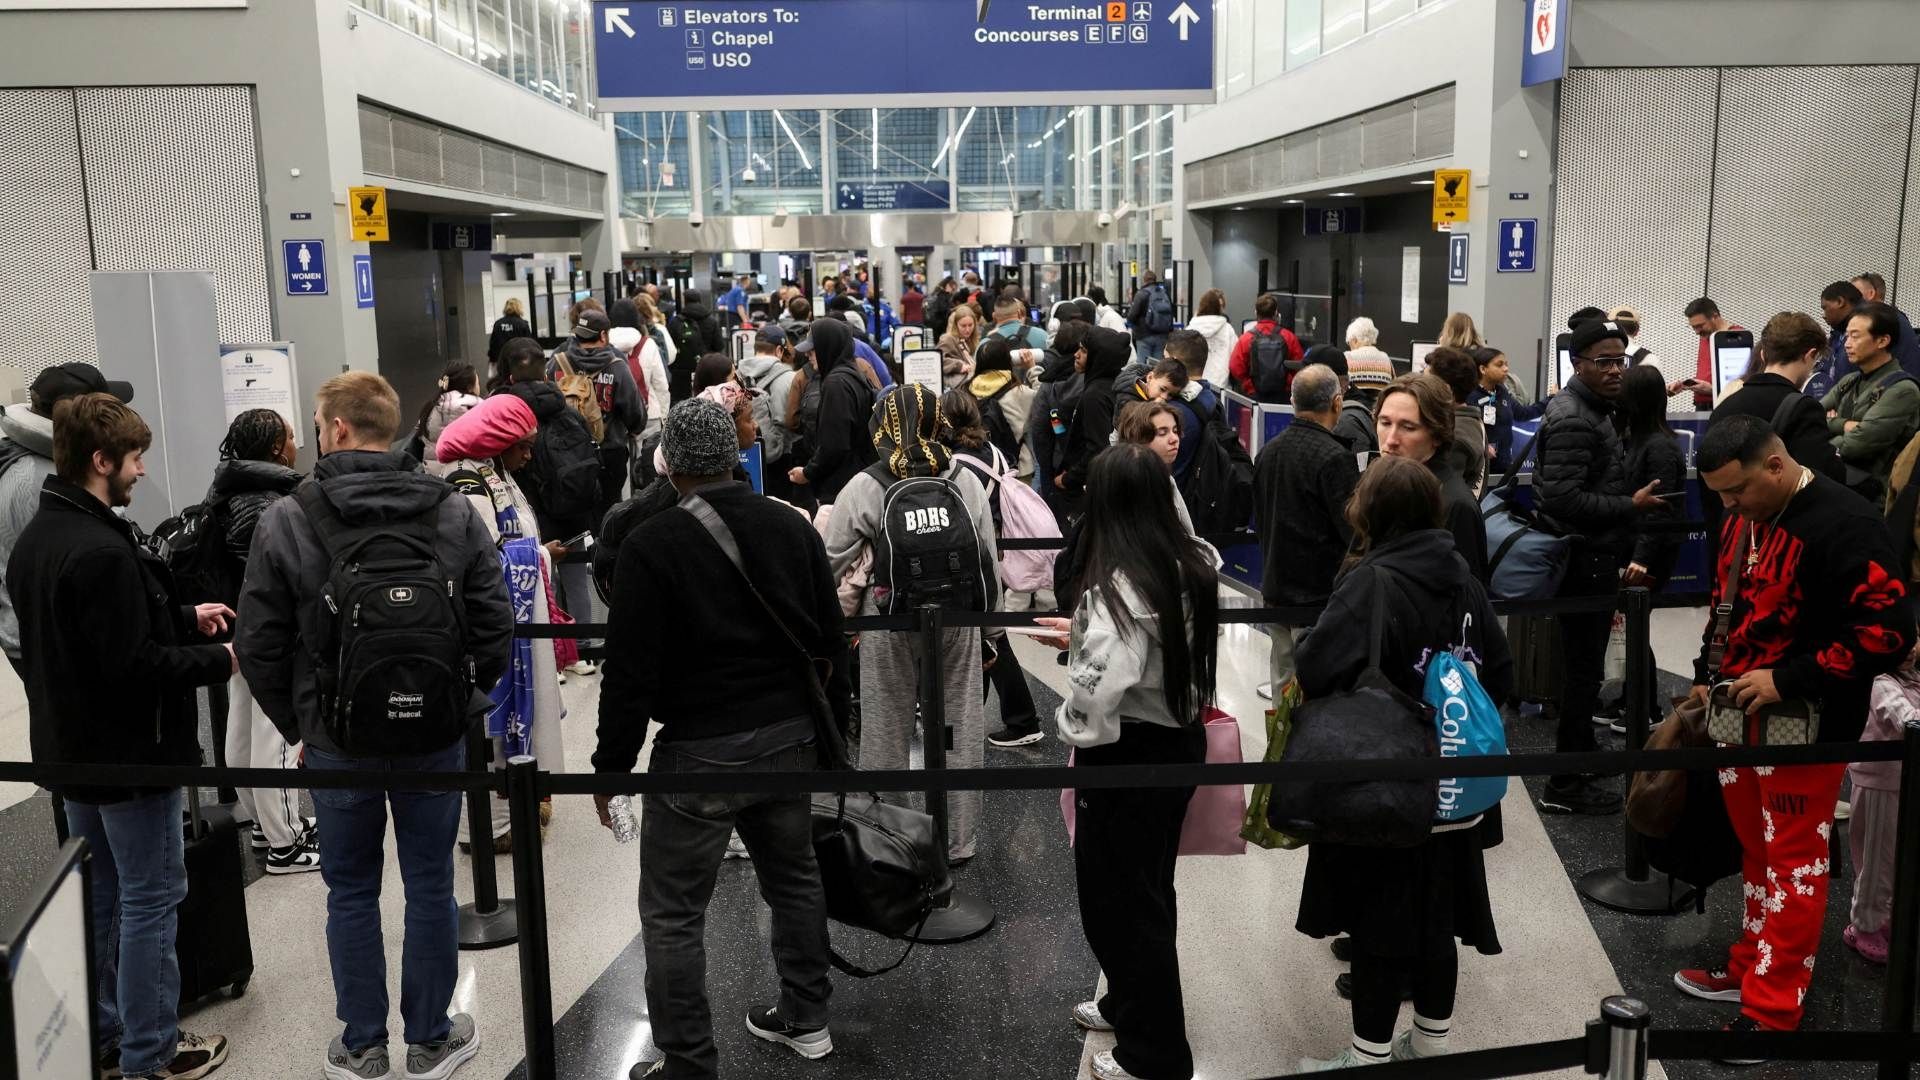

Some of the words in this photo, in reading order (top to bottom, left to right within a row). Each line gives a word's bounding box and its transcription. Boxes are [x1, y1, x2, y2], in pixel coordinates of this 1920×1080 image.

[684, 9, 768, 24] Elevators
[773, 8, 799, 23] To:
[1028, 5, 1102, 20] Terminal
[1112, 5, 1121, 19] 2
[712, 31, 773, 48] Chapel
[974, 28, 1079, 42] Concourses
[1089, 27, 1100, 40] E
[1111, 27, 1122, 40] F
[1132, 26, 1145, 40] G
[712, 52, 751, 67] USO
[1508, 250, 1525, 258] MEN
[501, 323, 513, 332] TSA
[905, 507, 950, 531] BDHS
[916, 523, 942, 535] cheer
